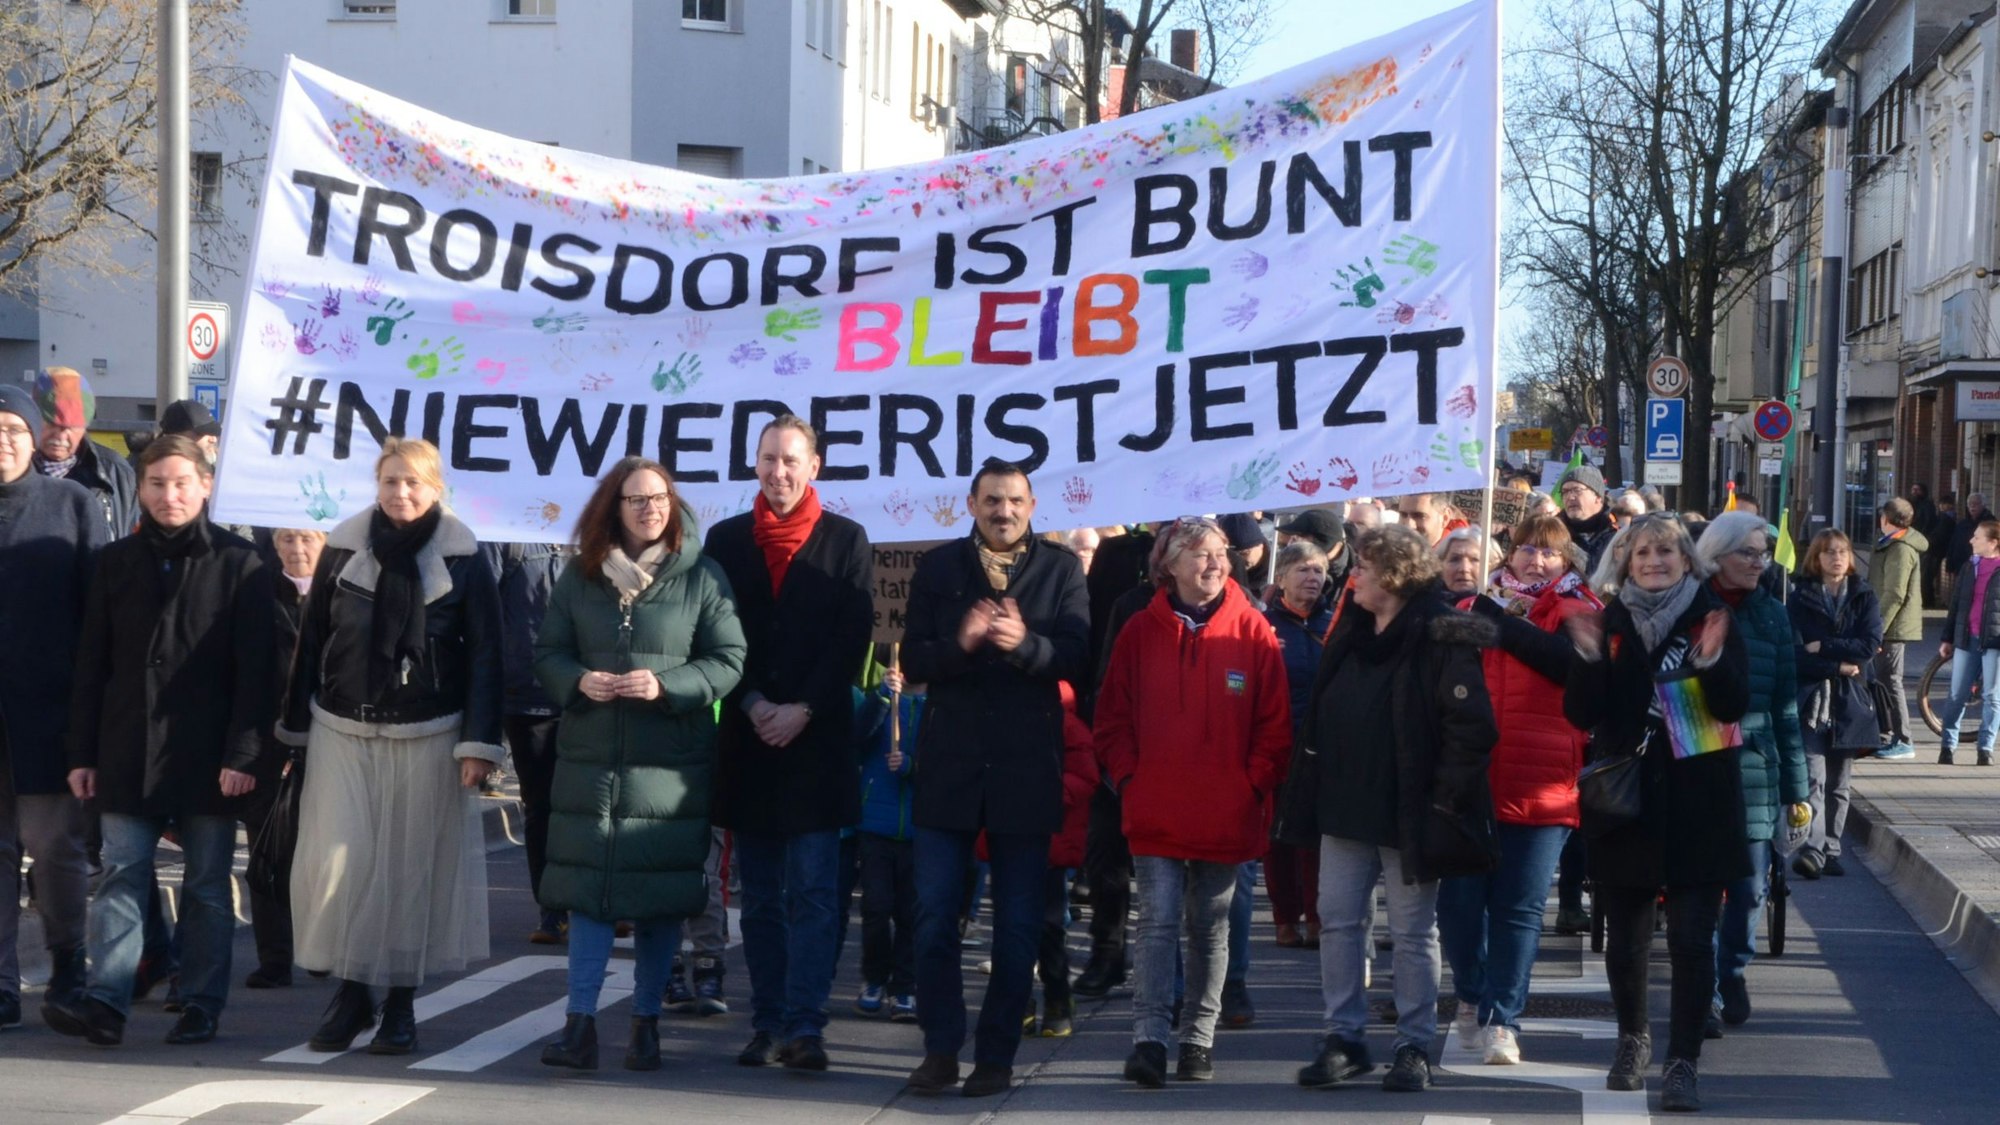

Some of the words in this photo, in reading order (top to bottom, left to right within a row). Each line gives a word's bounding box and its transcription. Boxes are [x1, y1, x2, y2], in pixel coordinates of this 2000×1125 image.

[292, 170, 900, 314] TROISDORF
[934, 195, 1097, 290] IST
[1131, 131, 1432, 258] BUNT
[834, 267, 1210, 371] BLEIBT
[194, 326, 212, 347] 30
[192, 363, 215, 376] ZONE
[1656, 368, 1679, 386] 30
[1652, 403, 1668, 428] P
[1493, 490, 1523, 502] STOP
